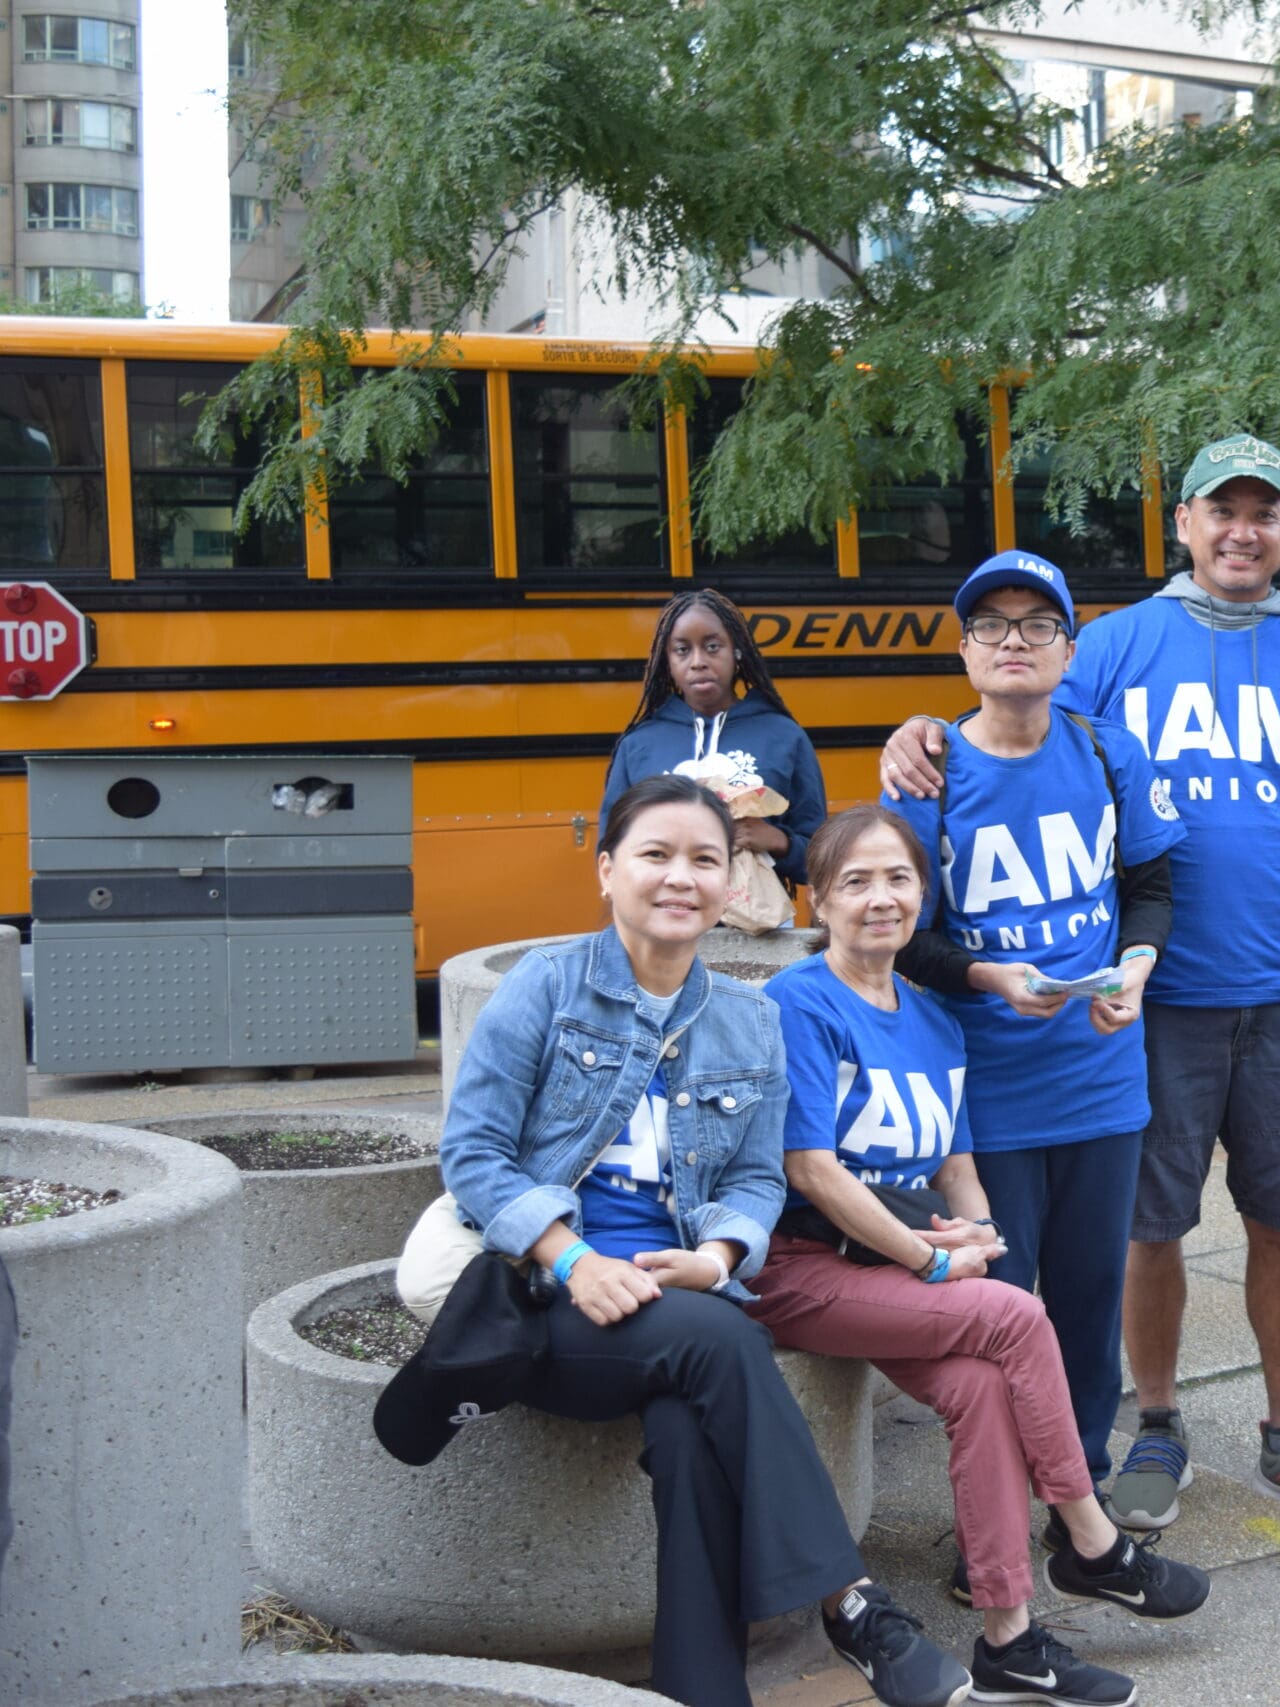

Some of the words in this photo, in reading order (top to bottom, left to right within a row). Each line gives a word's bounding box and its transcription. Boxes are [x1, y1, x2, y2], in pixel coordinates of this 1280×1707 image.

[1017, 558, 1054, 580] IAM
[0, 621, 67, 662] TOP
[749, 612, 945, 650] DENN
[961, 900, 1111, 950] UNION
